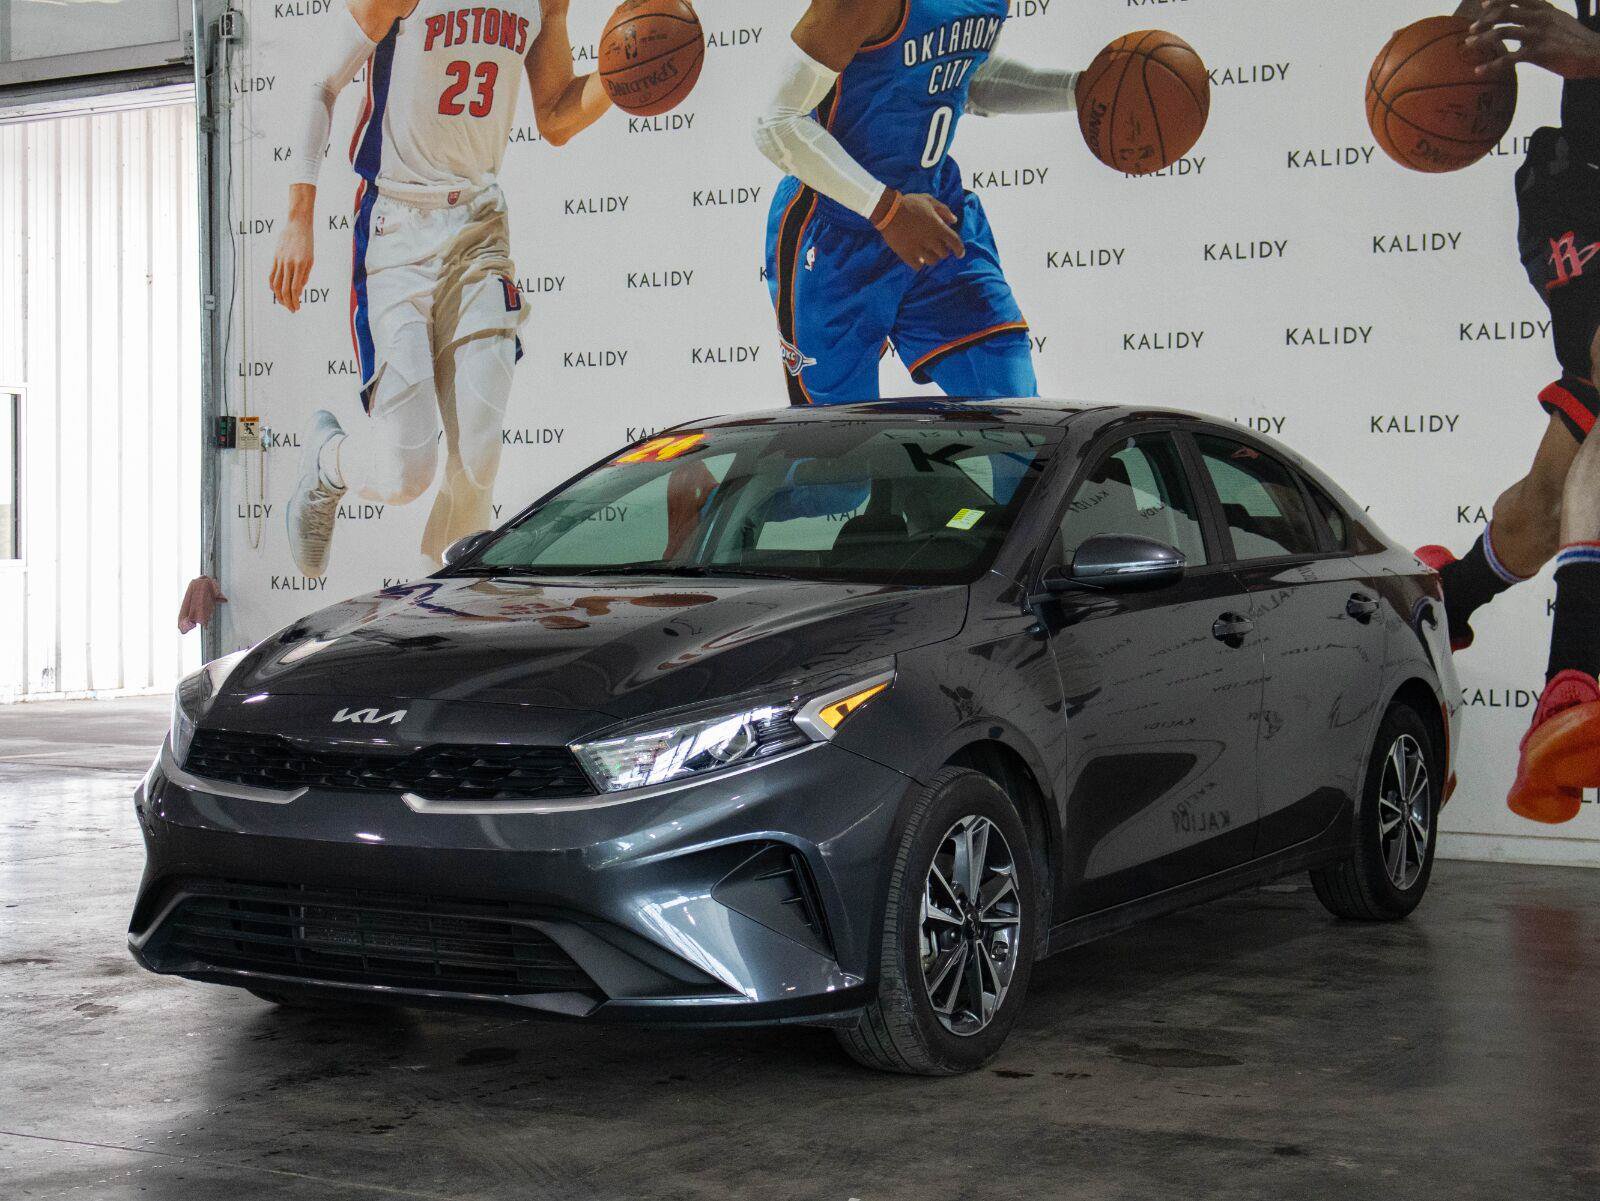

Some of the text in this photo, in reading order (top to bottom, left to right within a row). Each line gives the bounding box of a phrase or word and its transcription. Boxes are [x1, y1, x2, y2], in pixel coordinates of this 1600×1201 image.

[275, 0, 331, 18] KALIDY
[424, 7, 529, 55] PISTONS
[904, 17, 999, 67] OKLAHOM
[928, 59, 972, 95] CITY
[1207, 63, 1290, 86] KALIDY
[438, 60, 499, 118] 23
[628, 114, 695, 133] KALIDY
[921, 106, 952, 169] 0
[1287, 147, 1374, 168] KALIDY
[973, 168, 1048, 188] KALIDY
[565, 196, 628, 214] KALIDY
[693, 187, 760, 206] KALIDY
[1204, 240, 1288, 260] KALIDY
[1373, 232, 1461, 253] KALIDY
[1047, 249, 1125, 268] KALIDY
[628, 270, 693, 288] KALIDY
[1123, 331, 1204, 350] KALIDY
[1286, 326, 1372, 345] KALIDY
[1460, 321, 1551, 341] KALIDY
[564, 351, 628, 367] KALIDY
[692, 346, 759, 363] KALIDY
[239, 361, 274, 376] LIDY
[1371, 415, 1459, 433] KALIDY
[272, 433, 300, 447] KAL
[502, 429, 564, 444] KALIDY
[337, 505, 384, 519] ALIDY
[272, 575, 327, 590] KALIDY
[332, 708, 407, 724] KIA
